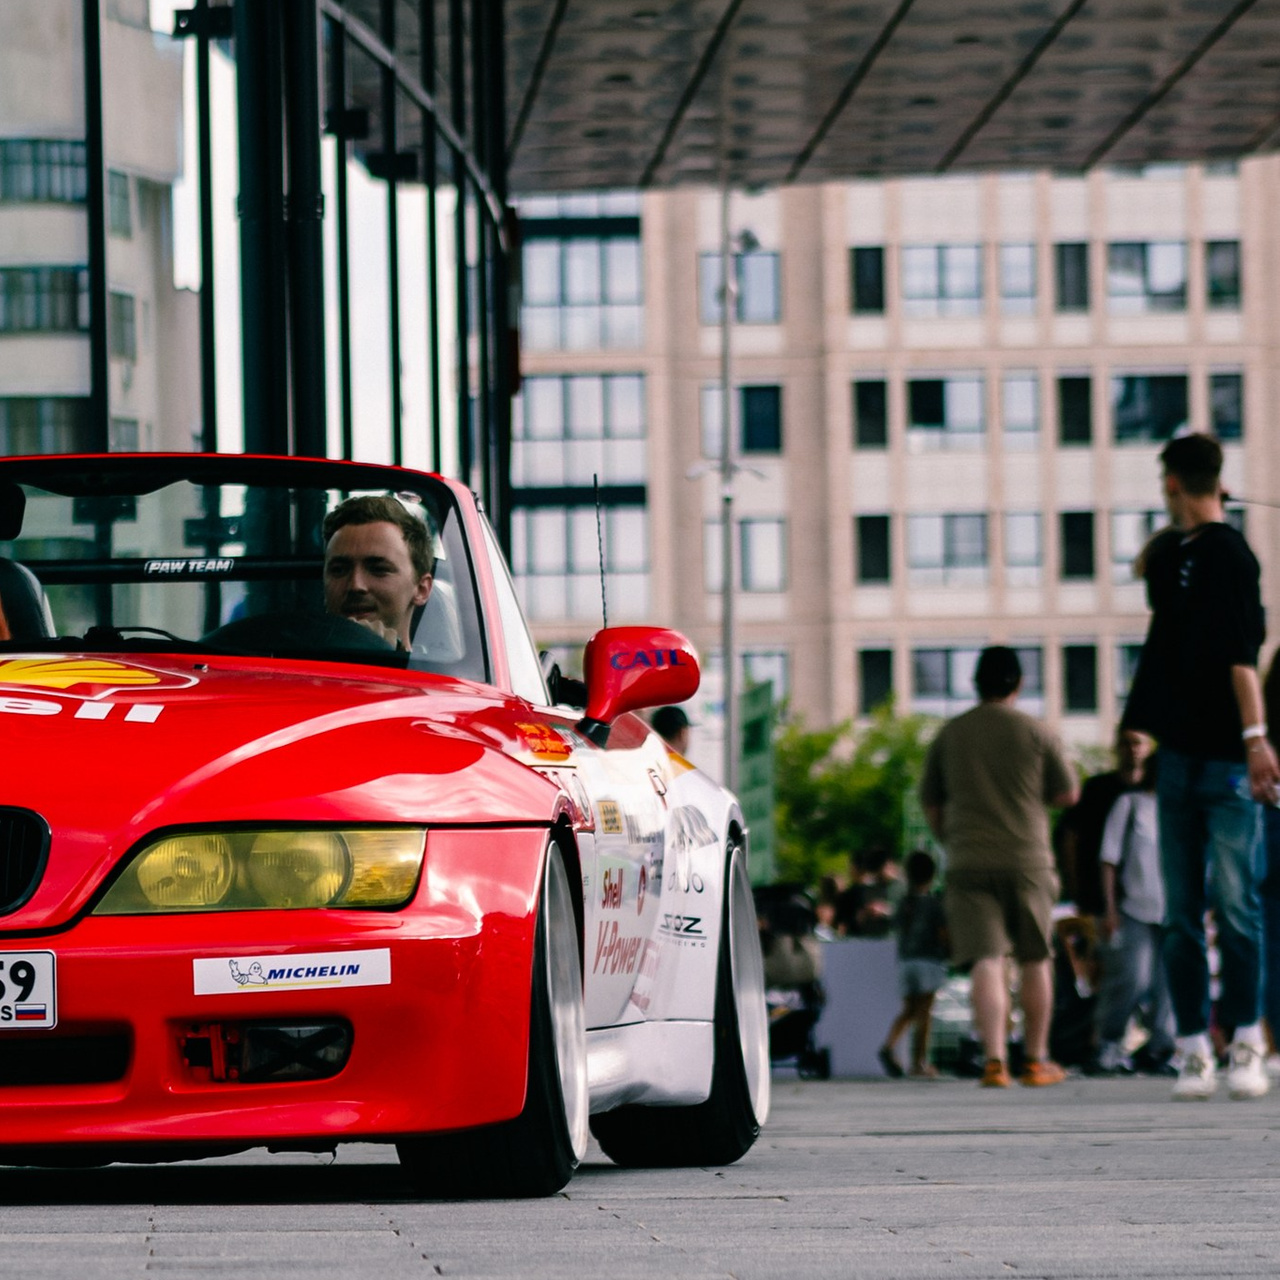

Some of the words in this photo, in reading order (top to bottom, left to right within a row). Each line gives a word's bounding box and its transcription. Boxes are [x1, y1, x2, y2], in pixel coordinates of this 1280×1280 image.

[148, 561, 186, 573] PAW
[188, 559, 231, 572] TEAM
[610, 648, 687, 671] CATL
[601, 867, 623, 909] Shell
[593, 920, 642, 976] V-Power
[267, 964, 360, 980] MICHELIN
